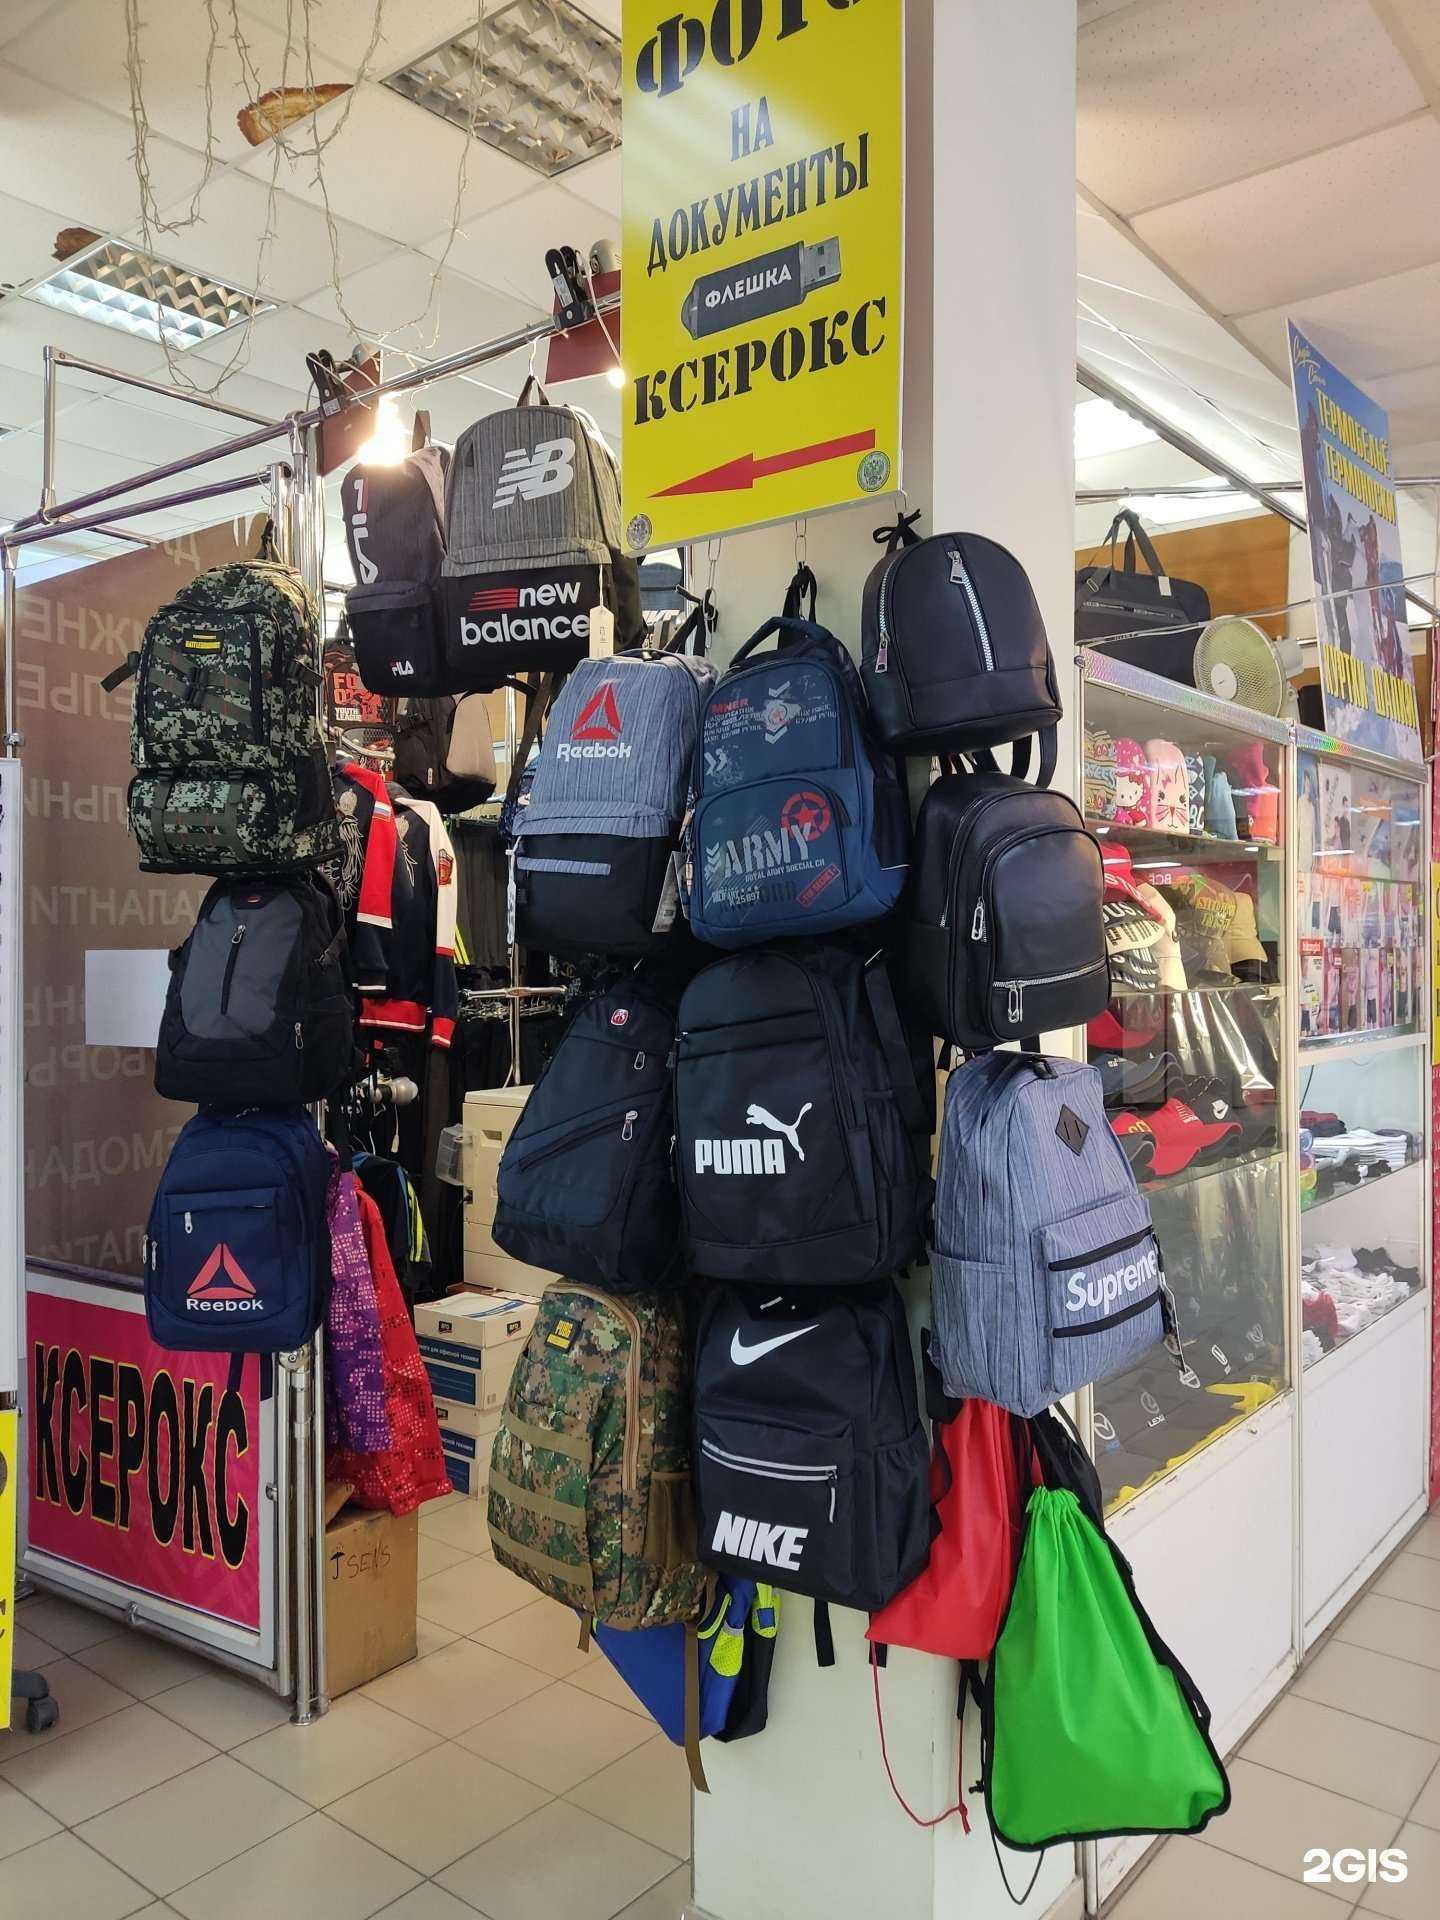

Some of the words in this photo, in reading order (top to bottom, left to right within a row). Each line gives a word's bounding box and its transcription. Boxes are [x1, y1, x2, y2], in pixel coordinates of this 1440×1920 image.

[635, 0, 863, 97] ФО
[730, 95, 775, 162] НА
[646, 132, 869, 278] ДОКУМЕНТЫ
[704, 263, 792, 309] ФЛЕШКА
[633, 296, 886, 425] КСЕРОКС
[519, 582, 581, 608] new
[460, 613, 591, 646] balance
[557, 743, 632, 763] Reebok
[724, 822, 812, 879] ARMY
[695, 1138, 787, 1175] PUMA
[186, 1298, 264, 1312] Reebok
[1065, 1250, 1157, 1316] Supreme
[34, 1341, 249, 1569] КСЕРОКС
[712, 1510, 808, 1573] NIKE
